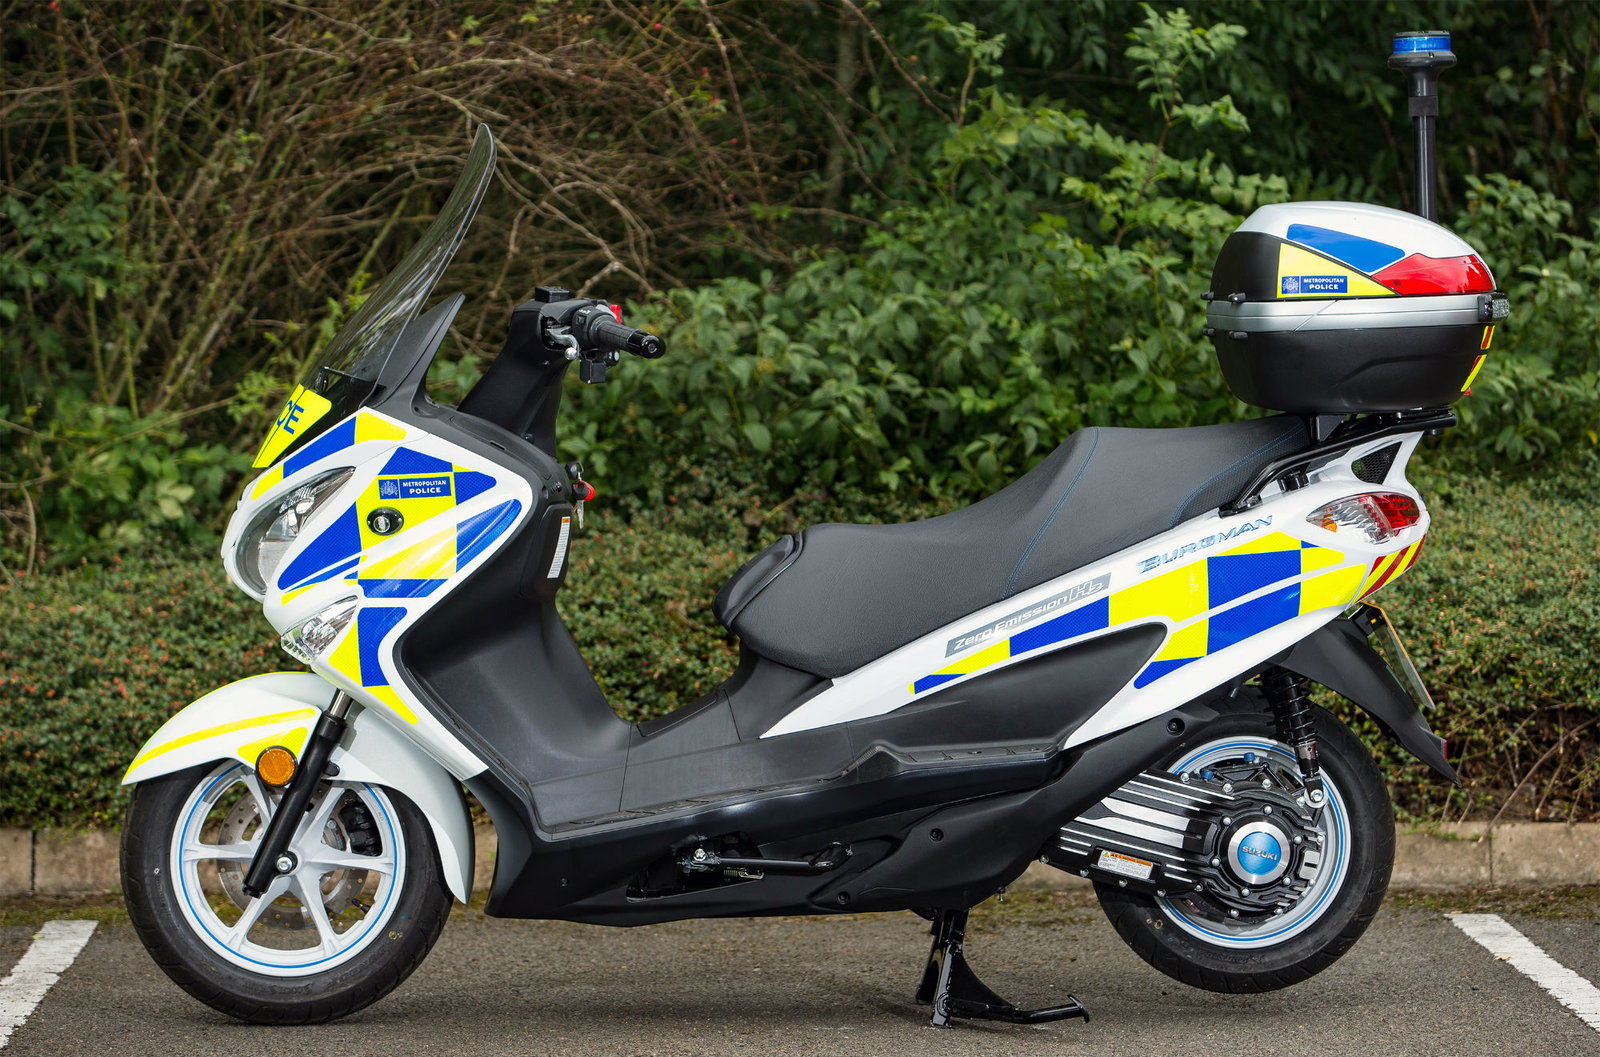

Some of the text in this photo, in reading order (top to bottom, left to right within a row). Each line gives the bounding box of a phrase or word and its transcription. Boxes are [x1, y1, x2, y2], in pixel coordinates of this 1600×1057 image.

[402, 479, 447, 487] METROPOLITAN
[1136, 515, 1273, 574] BURGMAN
[994, 596, 1068, 632] Emission
[1242, 845, 1278, 861] SUZUKI
